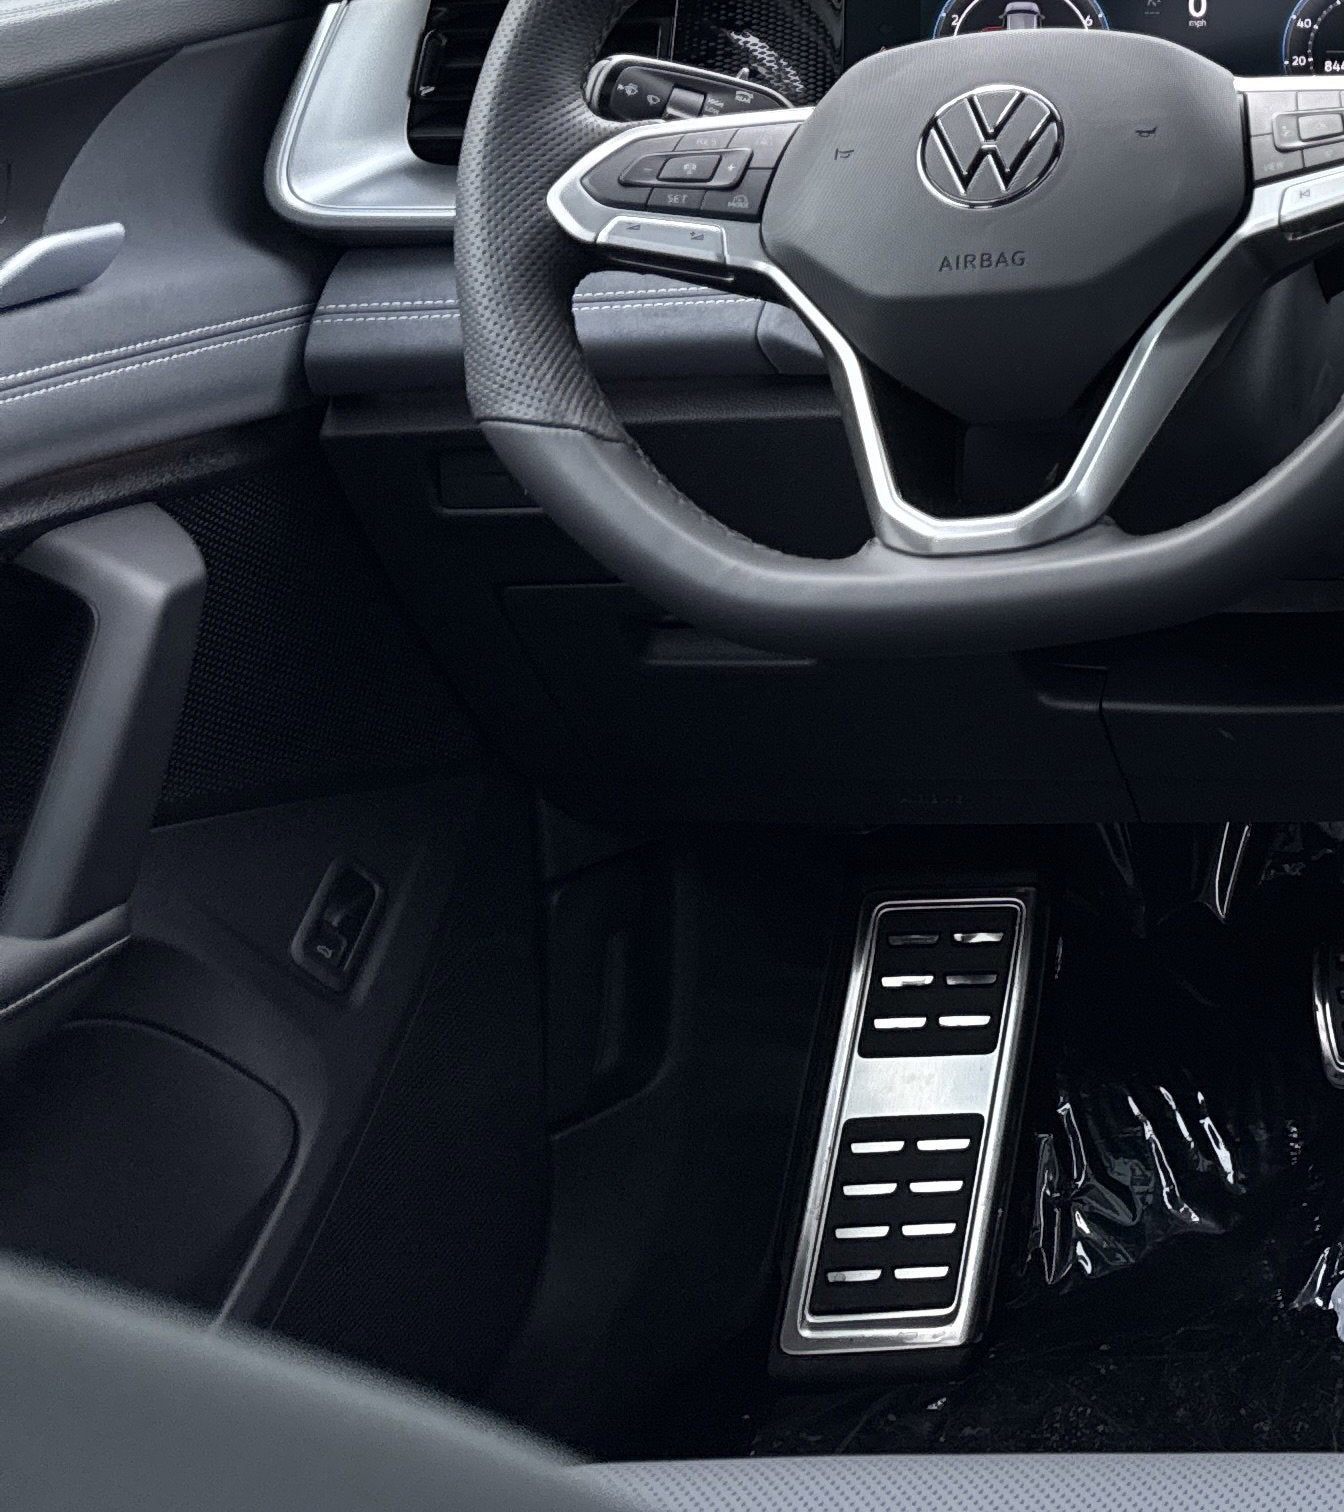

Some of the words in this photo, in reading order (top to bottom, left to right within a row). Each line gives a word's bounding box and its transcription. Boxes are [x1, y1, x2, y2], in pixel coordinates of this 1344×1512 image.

[951, 15, 959, 26] 2
[1084, 15, 1093, 26] 6
[1188, 19, 1207, 28] mph
[1296, 19, 1312, 28] 40
[1292, 56, 1307, 66] 20
[667, 193, 688, 204] SET
[938, 250, 1026, 272] AIRBAG
